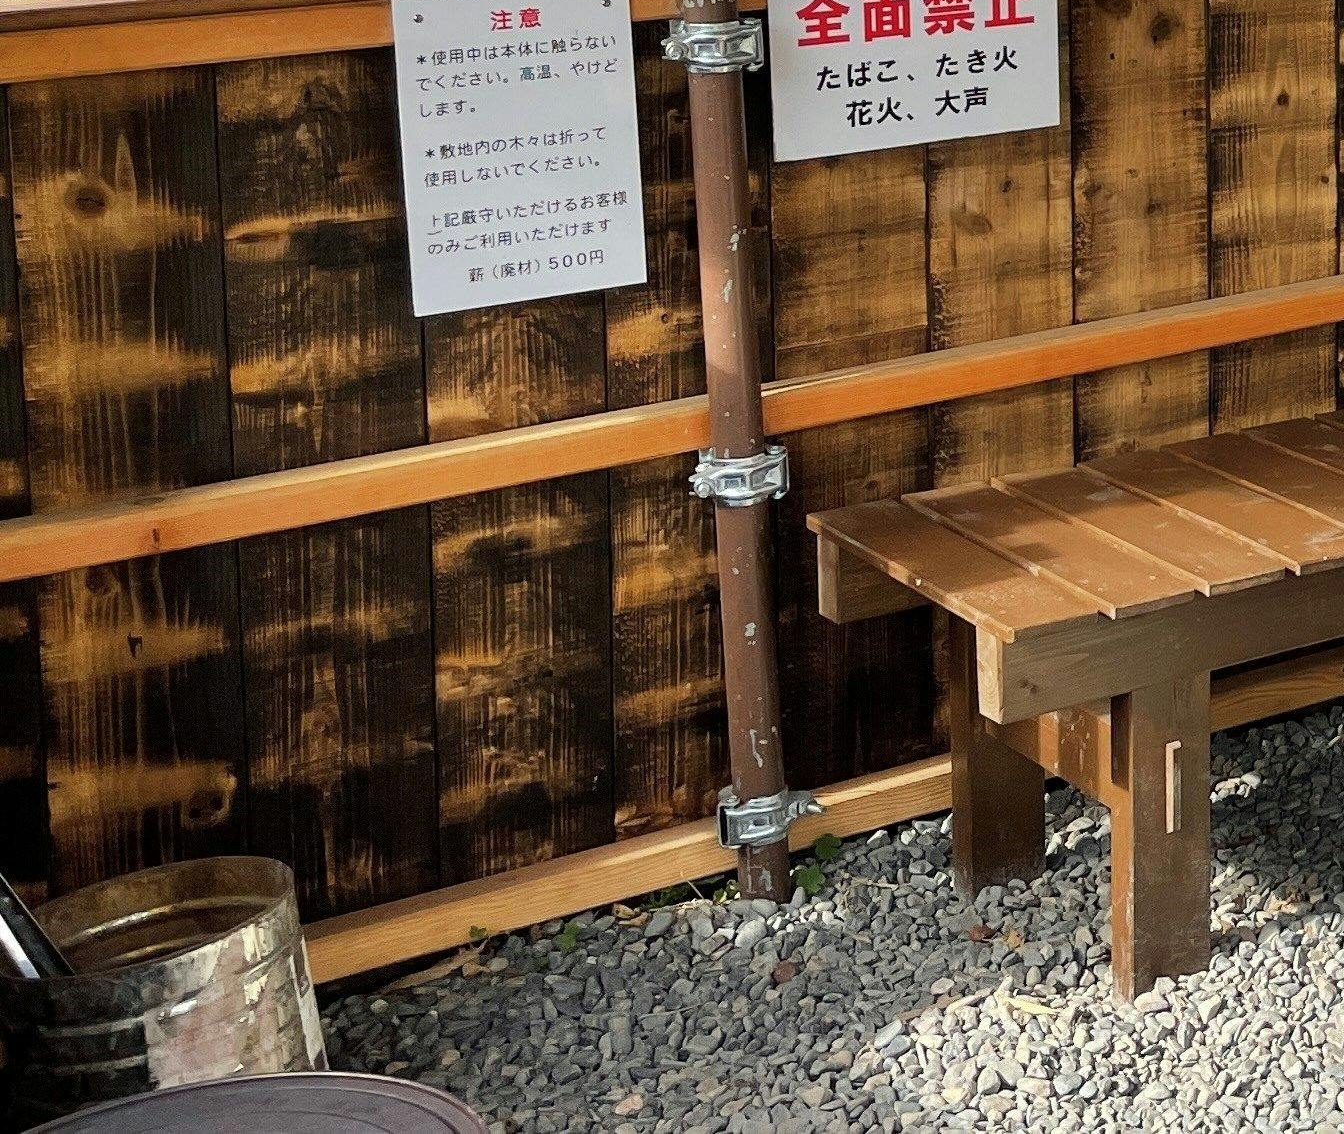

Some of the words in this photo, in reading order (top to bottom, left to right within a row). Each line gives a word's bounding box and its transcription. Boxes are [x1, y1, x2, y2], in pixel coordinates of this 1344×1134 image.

[490, 7, 542, 32] 注意
[415, 58, 618, 92] でください。高温、やけど
[816, 45, 1019, 92] たばこ、たき火
[420, 99, 477, 118] します。
[845, 86, 990, 128] 花火、大声
[424, 155, 601, 188] 使用しないでください。
[427, 190, 629, 236] 上記厳守いただけるお客様
[427, 218, 612, 256] のみご利用いただけます
